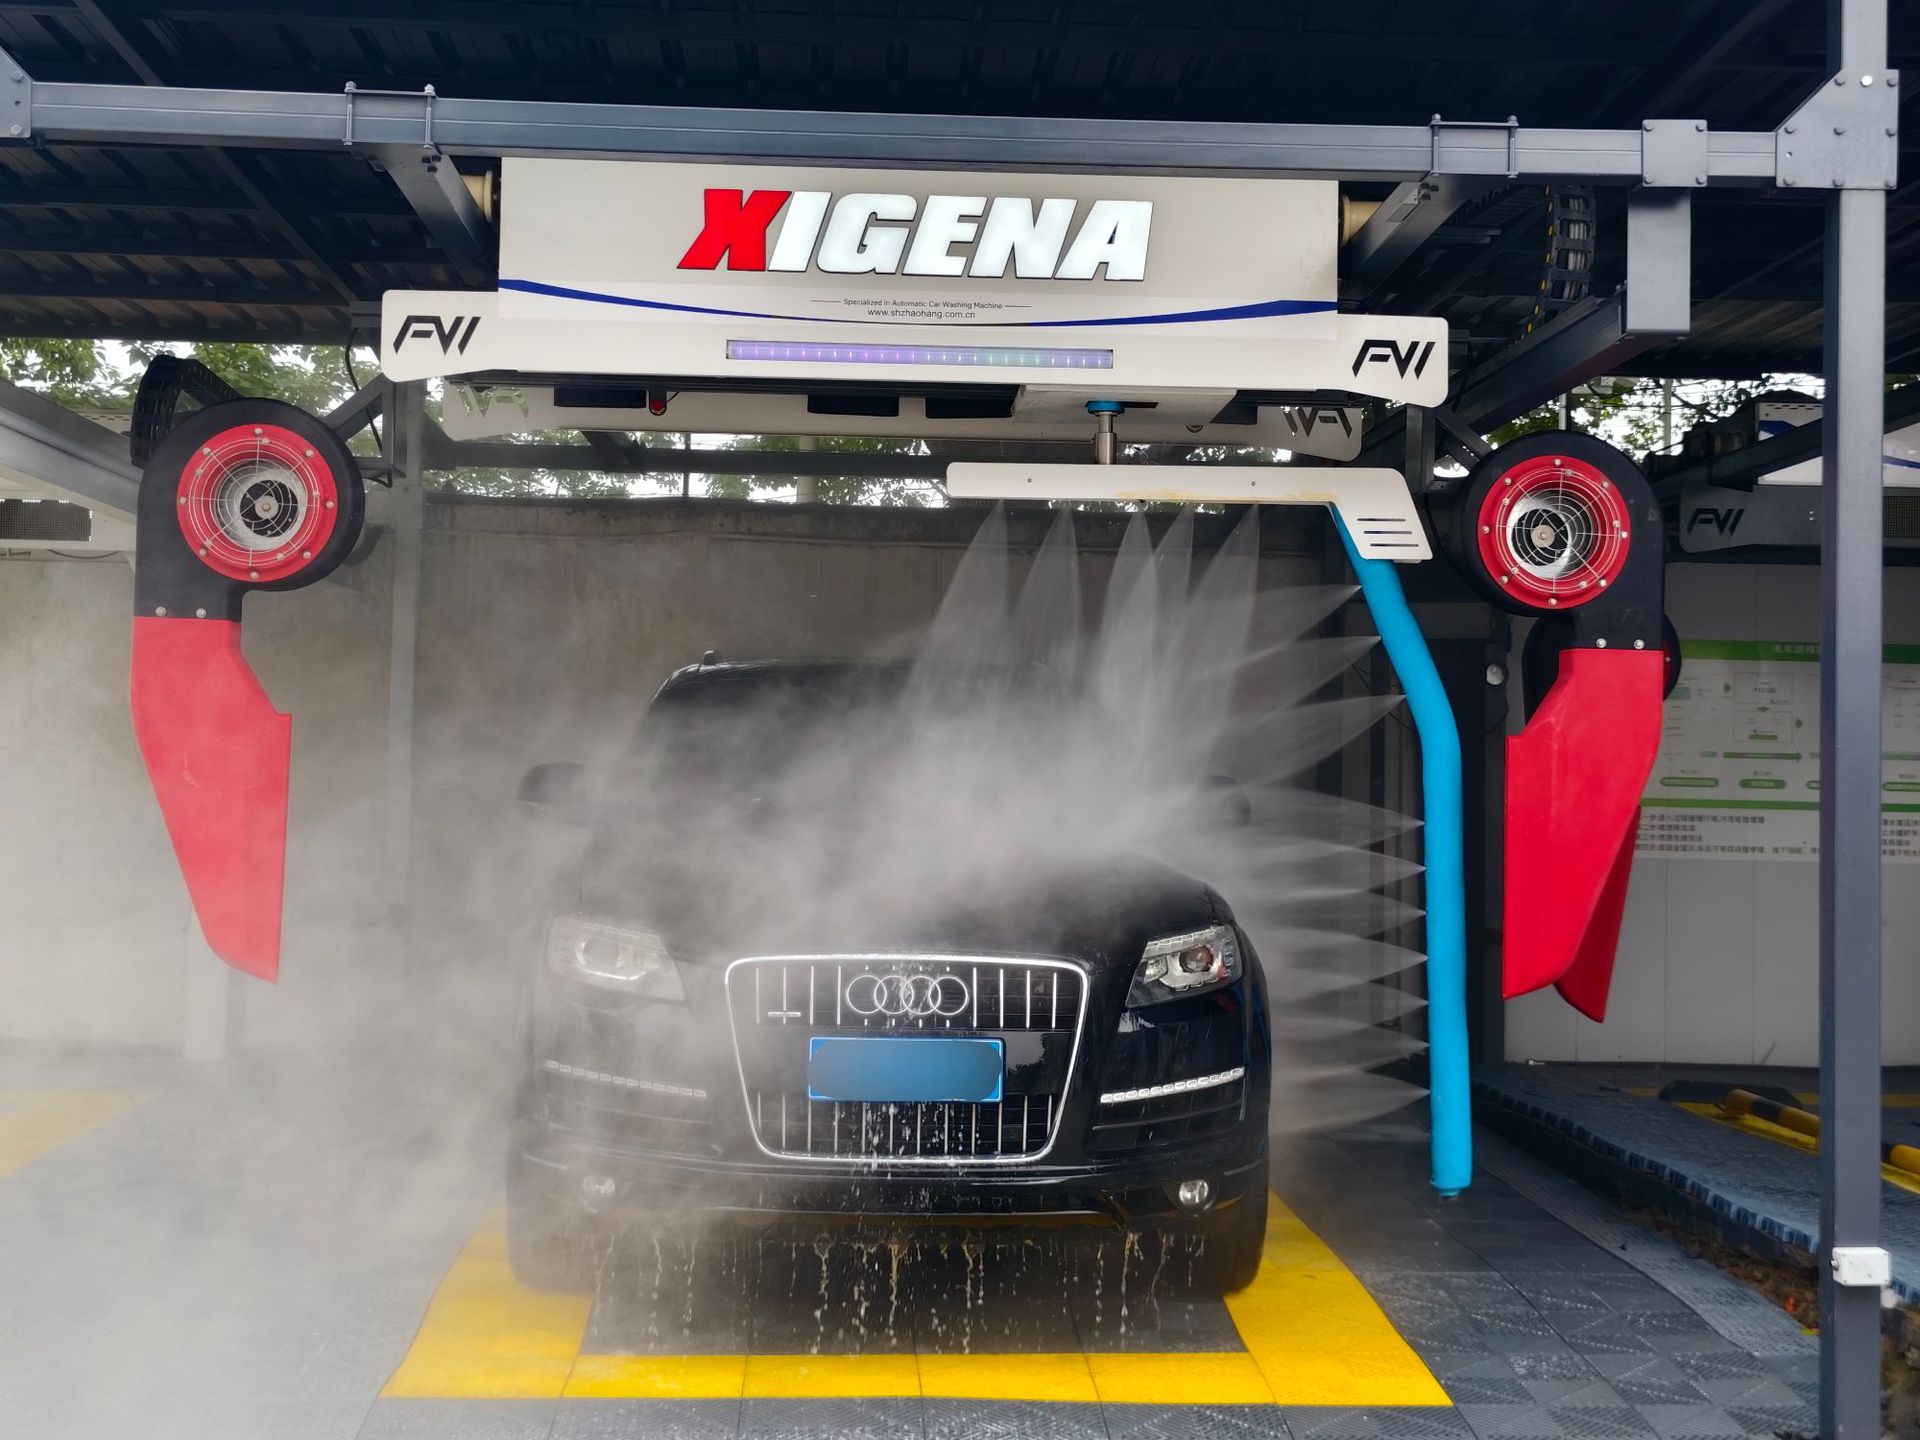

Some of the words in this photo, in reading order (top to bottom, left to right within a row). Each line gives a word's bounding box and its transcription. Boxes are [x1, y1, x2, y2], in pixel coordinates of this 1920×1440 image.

[676, 187, 1154, 283] XIGENA
[843, 297, 883, 308] Specialized
[892, 299, 928, 308] Automatic
[928, 300, 942, 309] Car
[942, 301, 973, 311] Washing
[974, 302, 1003, 310] Machine
[867, 307, 976, 320] www.shzhaohang.com.cn
